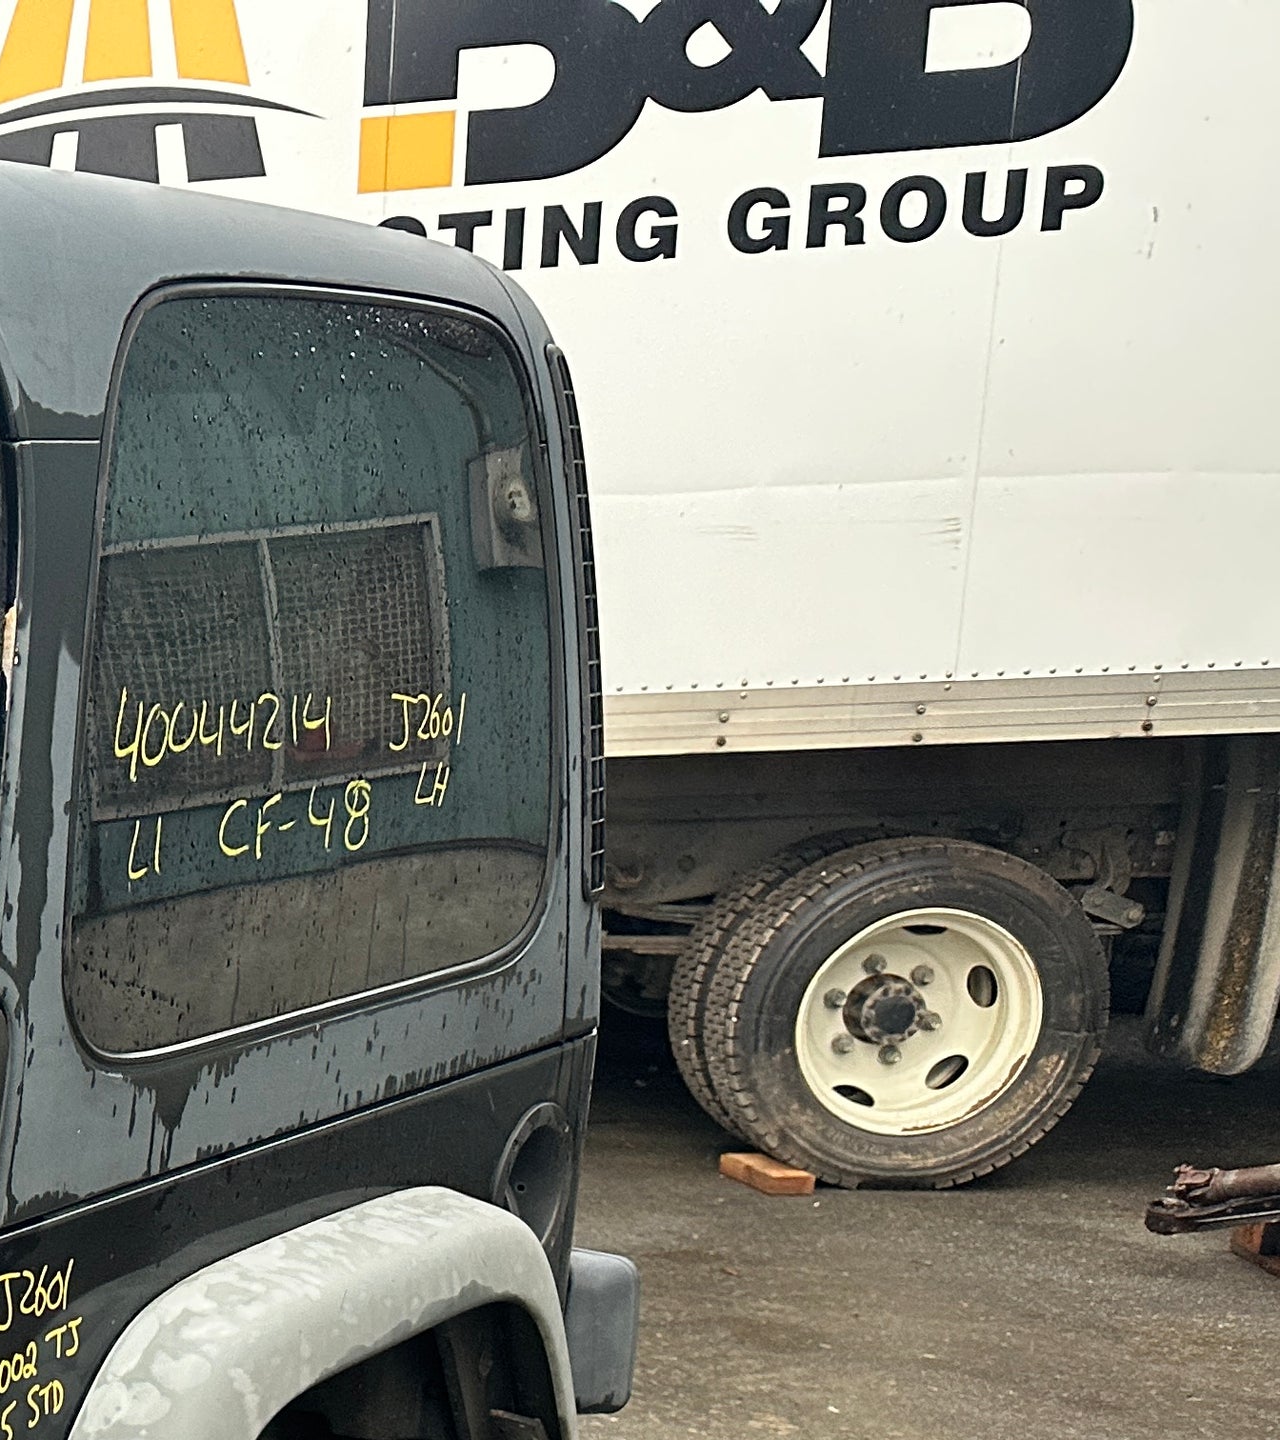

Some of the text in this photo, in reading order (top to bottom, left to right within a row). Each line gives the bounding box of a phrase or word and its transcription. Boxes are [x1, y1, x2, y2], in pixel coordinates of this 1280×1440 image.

[377, 163, 1105, 271] TING GROUP
[113, 686, 466, 782] 40044214 J2601
[414, 761, 450, 807] LH
[218, 779, 373, 860] CF-48
[44, 1316, 83, 1359] TJ
[27, 1379, 65, 1429] STD
